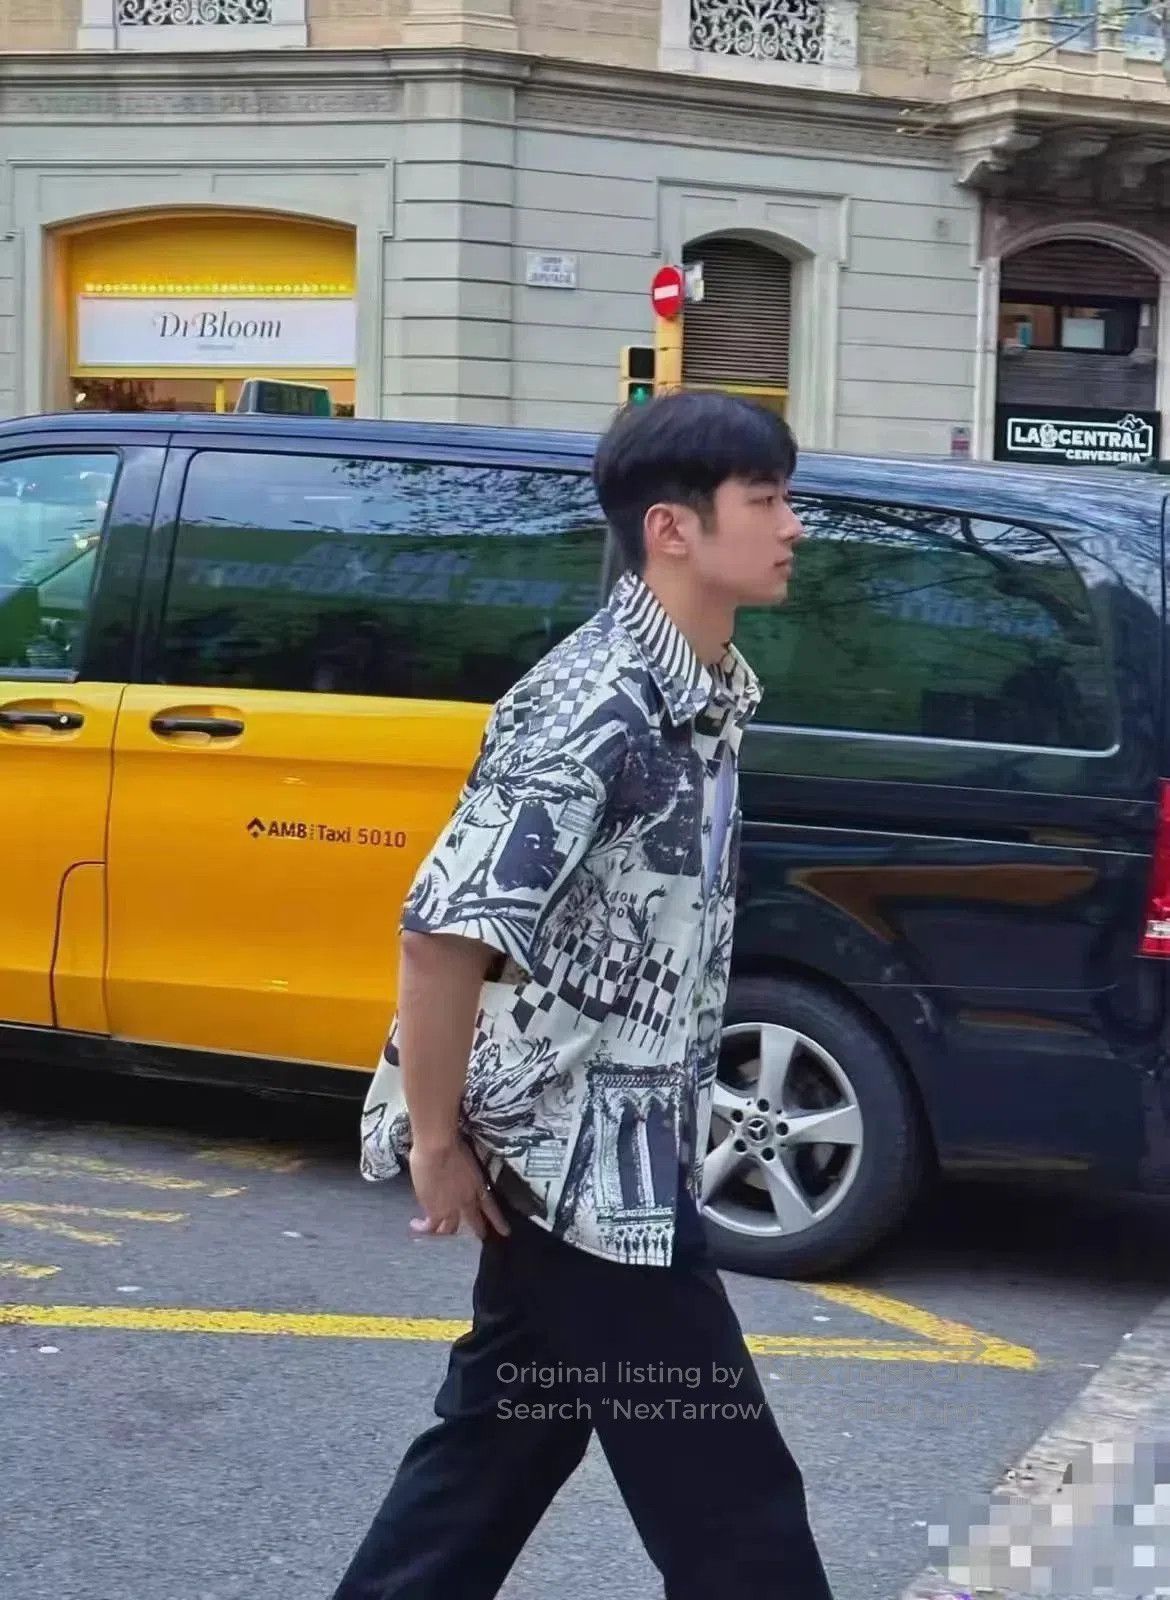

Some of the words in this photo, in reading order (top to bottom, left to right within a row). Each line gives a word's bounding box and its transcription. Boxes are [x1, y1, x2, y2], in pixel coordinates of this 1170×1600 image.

[191, 310, 281, 338] Bloom
[1014, 426, 1041, 443] LA
[1057, 429, 1147, 449] CENTRAL
[1065, 449, 1142, 463] CERVESERIA
[267, 820, 307, 839] AMB
[318, 824, 351, 843] Taxi
[357, 828, 407, 848] 5010
